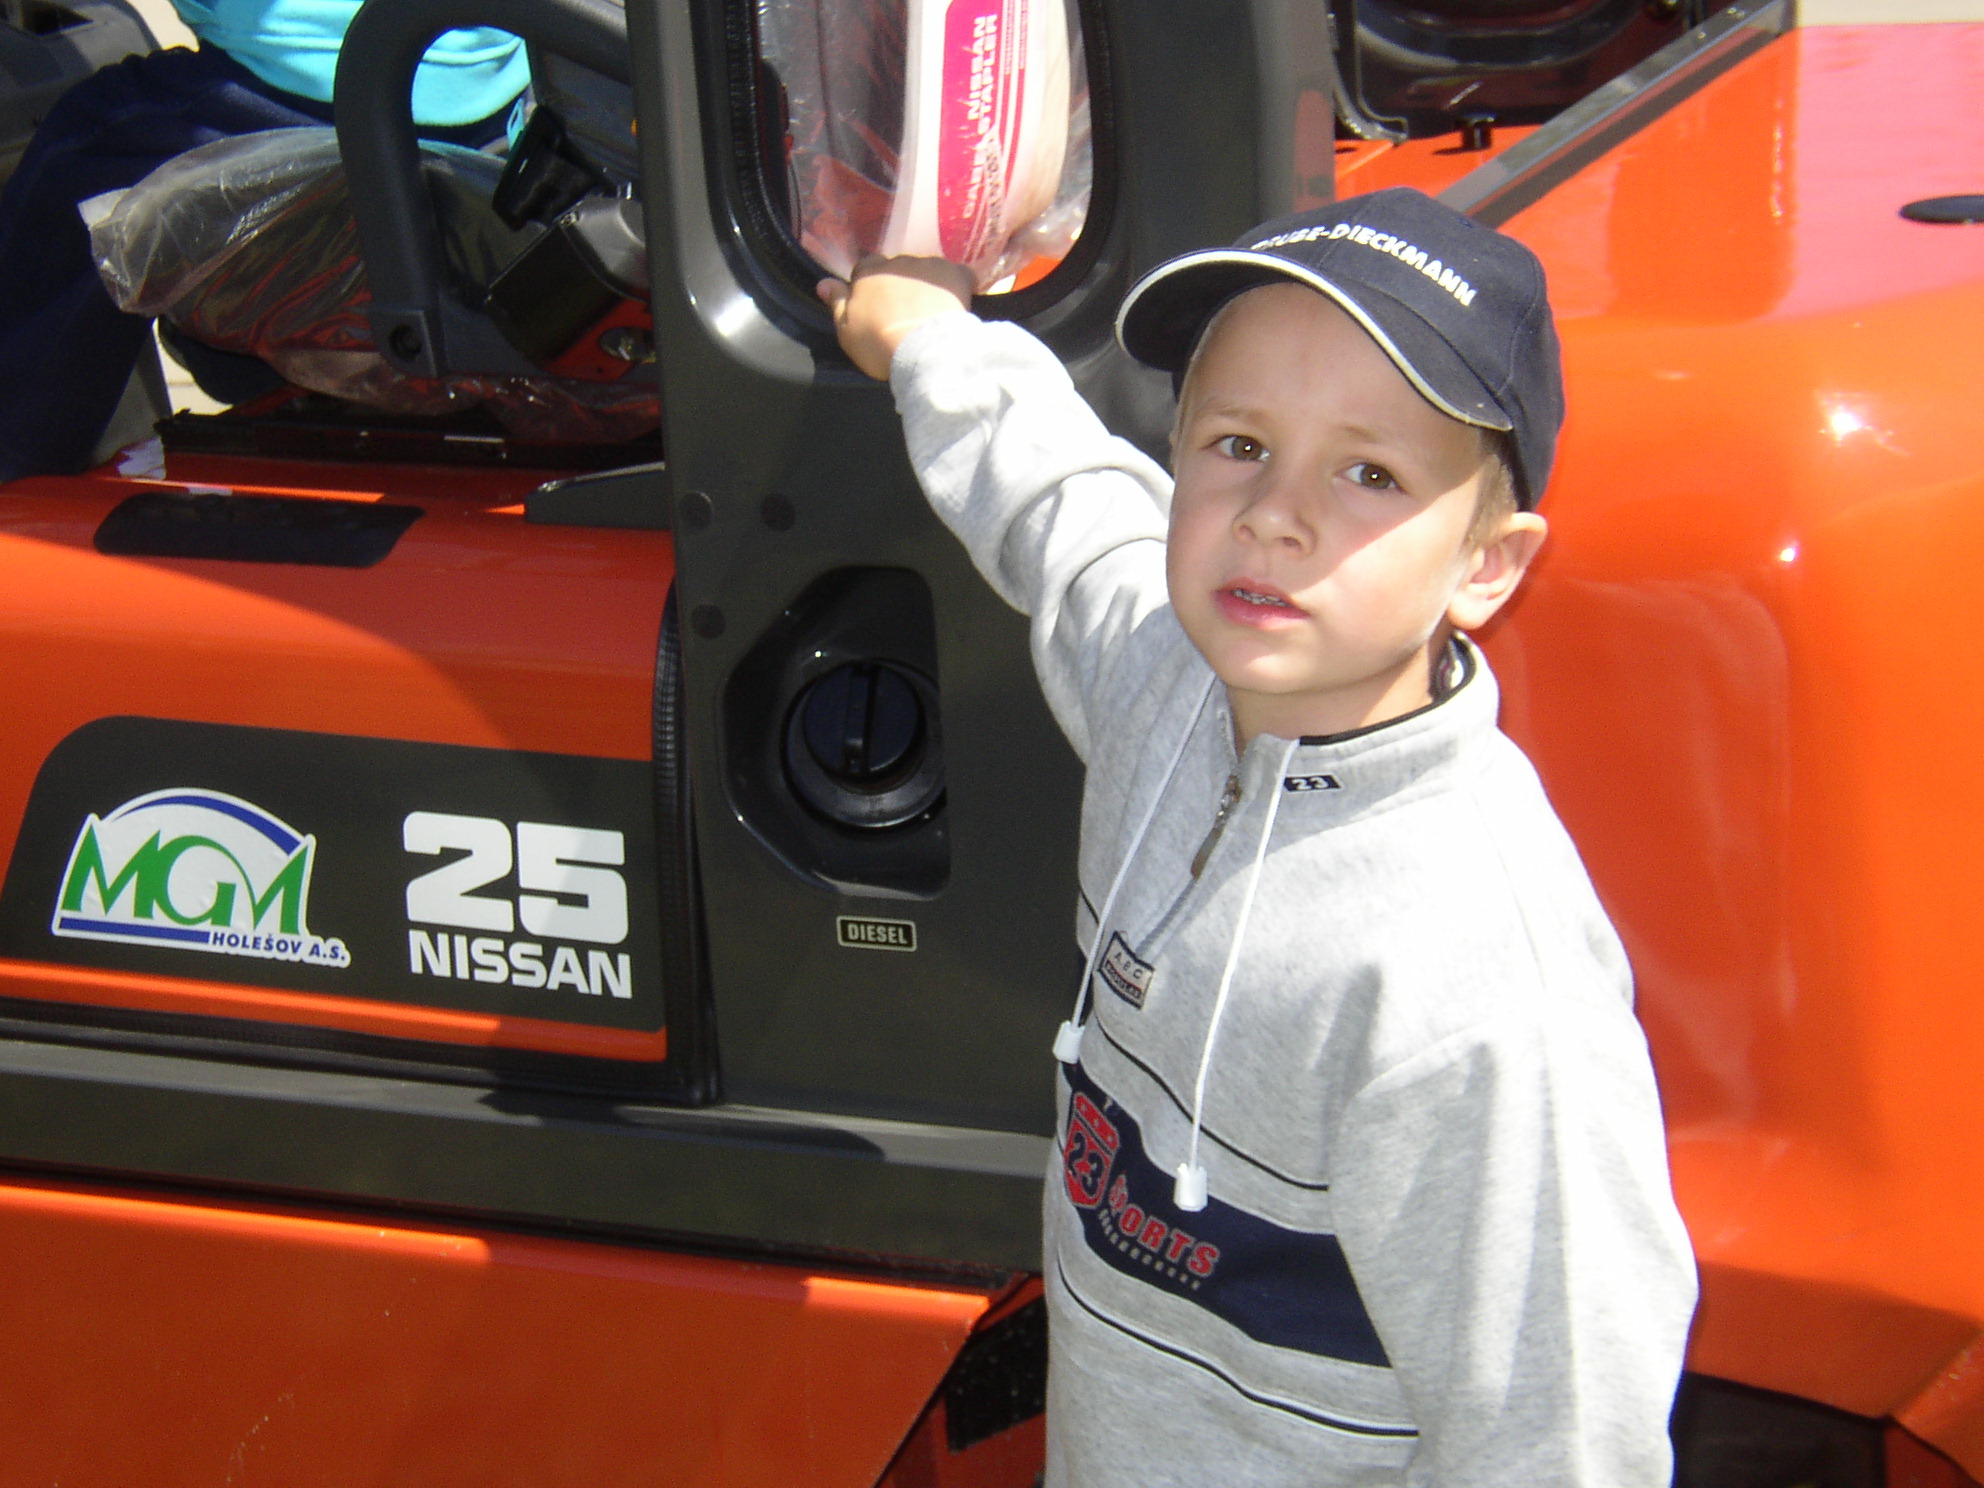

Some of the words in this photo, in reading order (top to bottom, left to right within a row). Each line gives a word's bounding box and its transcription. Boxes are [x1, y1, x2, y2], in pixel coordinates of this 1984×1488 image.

[968, 16, 986, 120] NISSAN
[1291, 776, 1329, 791] 23
[60, 824, 309, 935] MGM
[403, 810, 629, 944] 25
[211, 931, 303, 957] HOLEŠOV
[308, 943, 347, 963] A.S.
[409, 929, 633, 1000] NISSAN
[847, 922, 908, 944] DIESEL
[1067, 1131, 1106, 1199] 23
